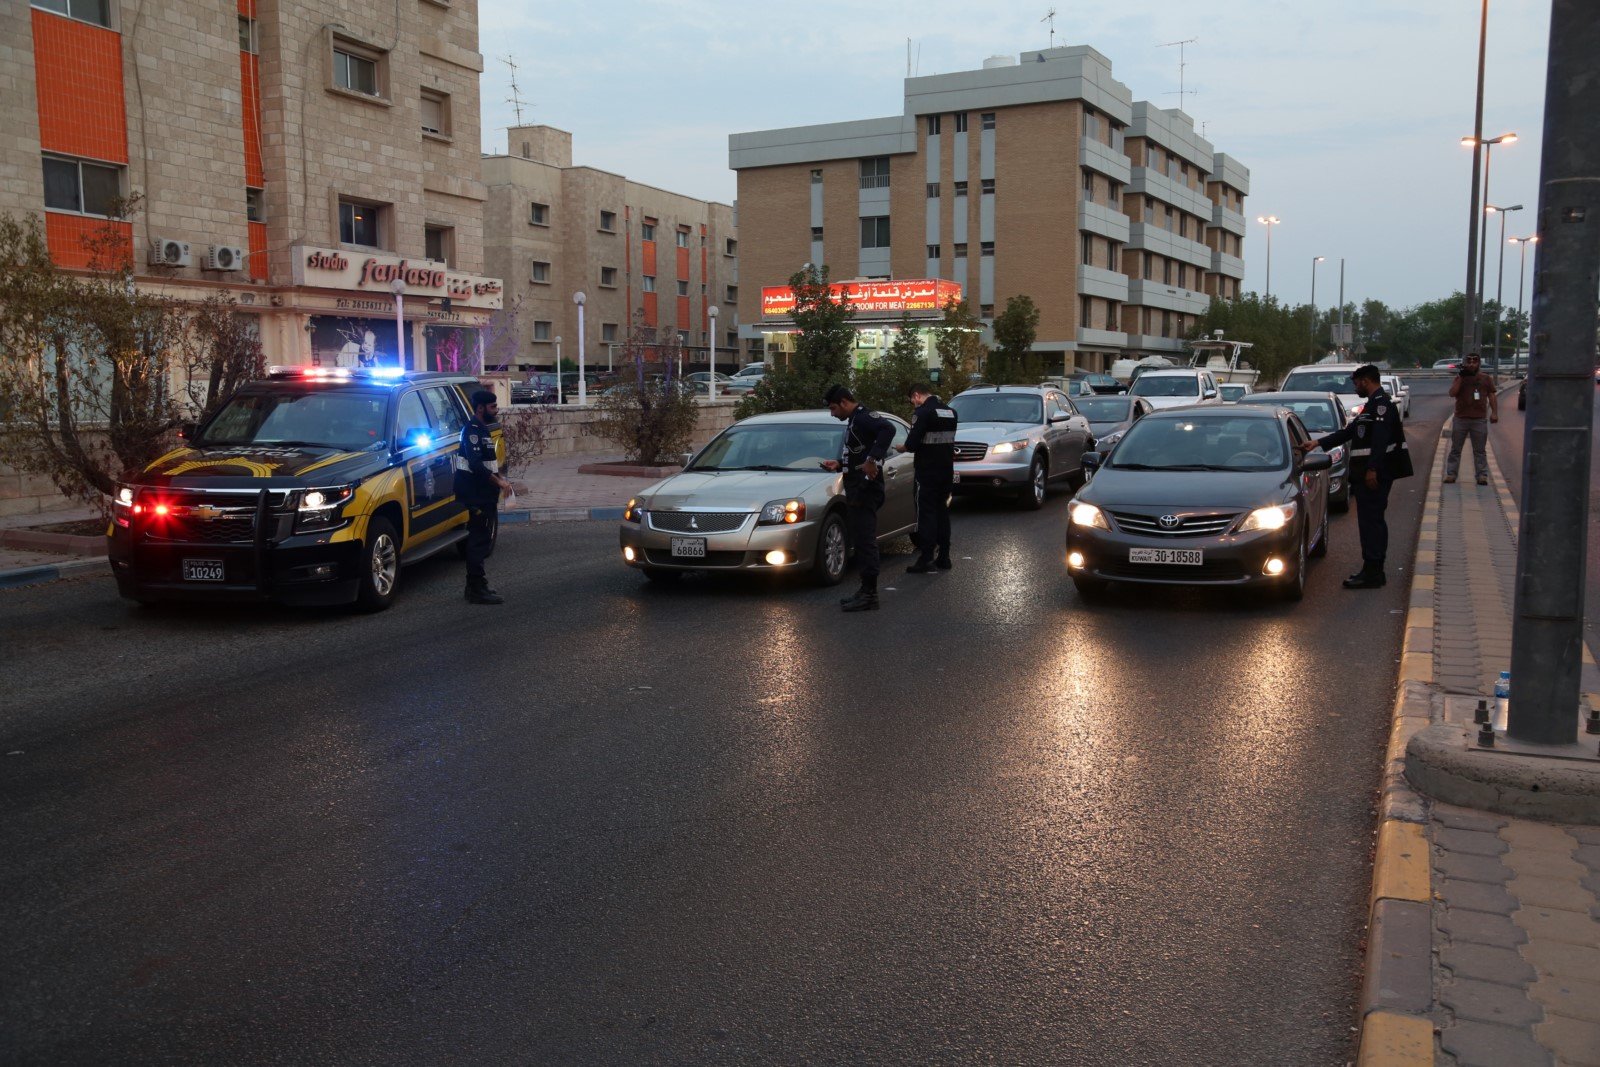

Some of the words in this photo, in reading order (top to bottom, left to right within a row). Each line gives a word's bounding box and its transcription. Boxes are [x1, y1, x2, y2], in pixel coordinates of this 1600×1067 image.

[308, 252, 348, 270] studio
[359, 258, 445, 286] fantasia
[901, 287, 935, 299] معرض
[876, 301, 888, 310] FOR
[889, 300, 906, 309] MEAT
[677, 547, 703, 555] 68866
[1155, 551, 1200, 563] 30-18588
[190, 568, 222, 578] 10249
